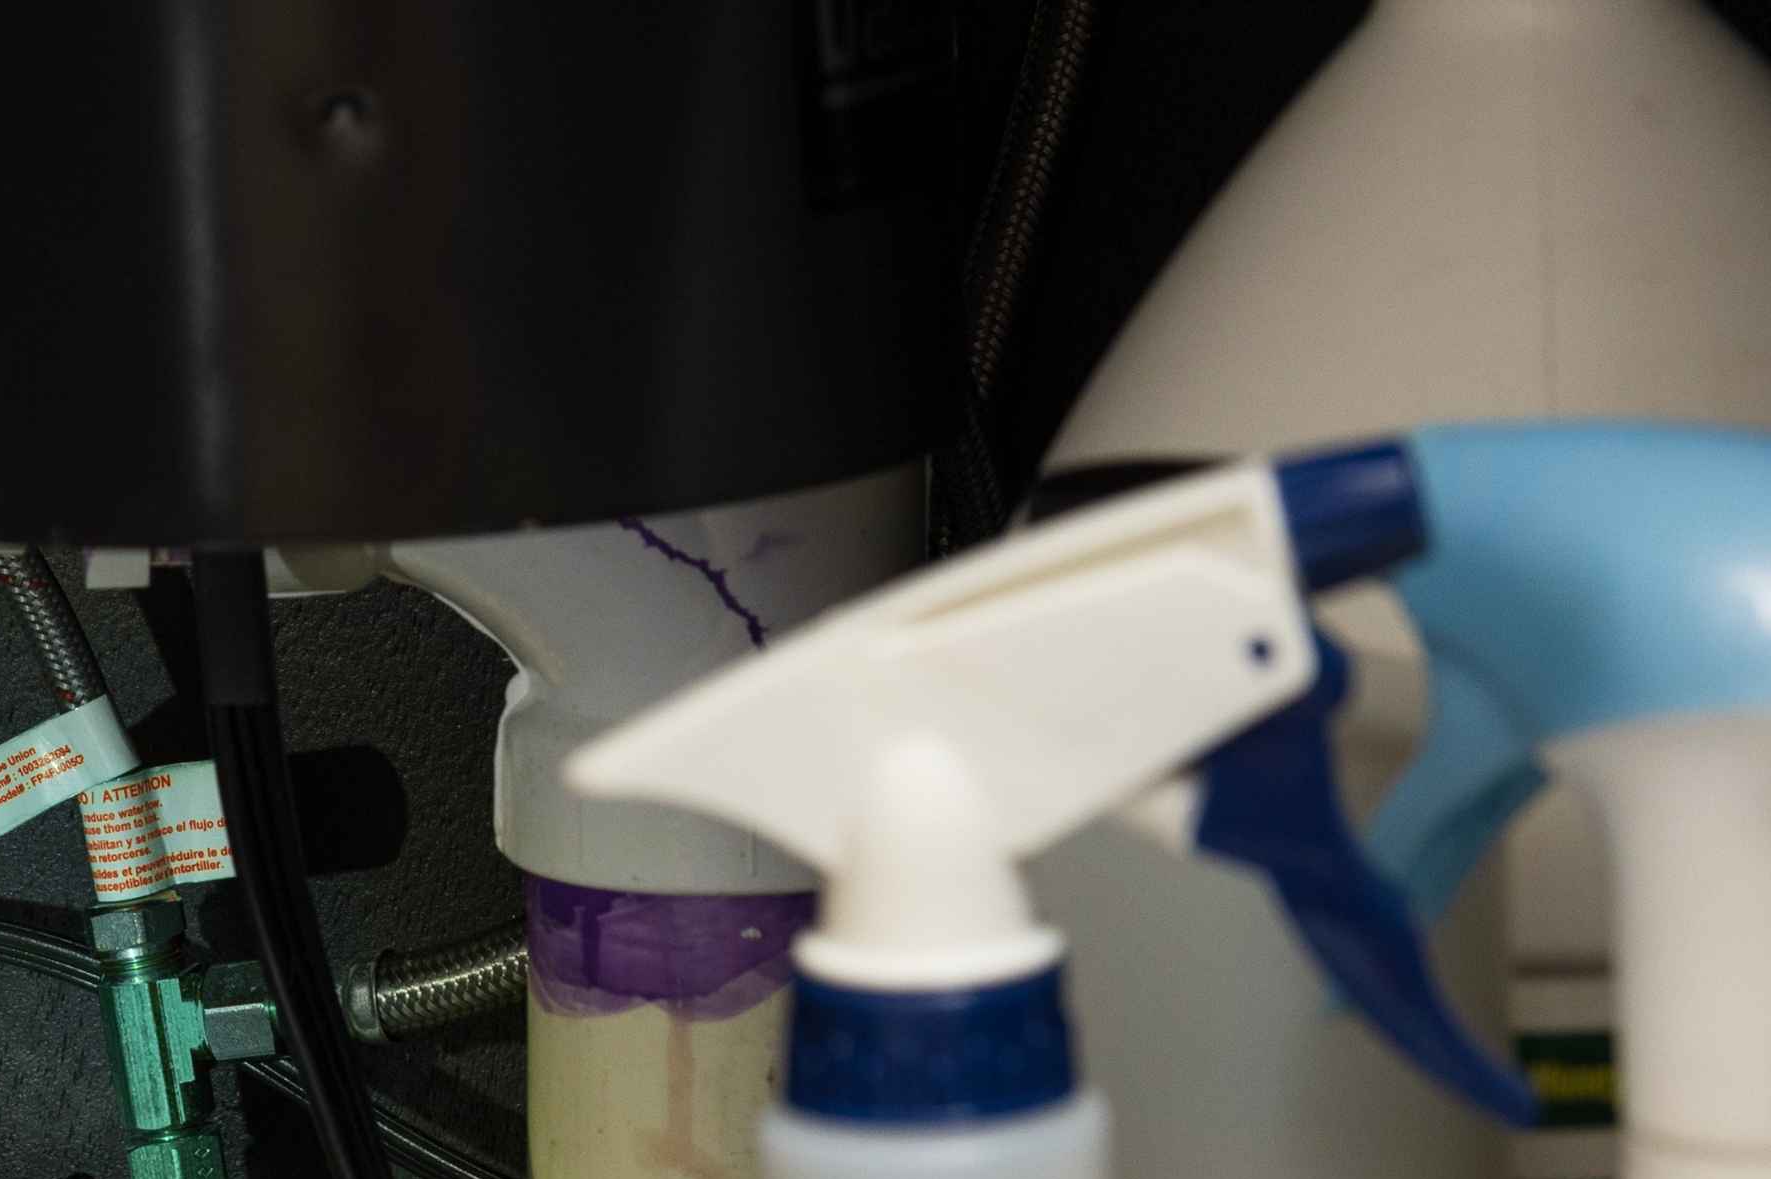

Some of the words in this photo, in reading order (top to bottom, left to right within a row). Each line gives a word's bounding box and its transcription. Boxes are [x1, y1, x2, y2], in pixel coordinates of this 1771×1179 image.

[7, 747, 36, 766] Union
[102, 774, 172, 803] ATTENTION
[103, 820, 132, 834] them
[189, 819, 214, 832] flujo
